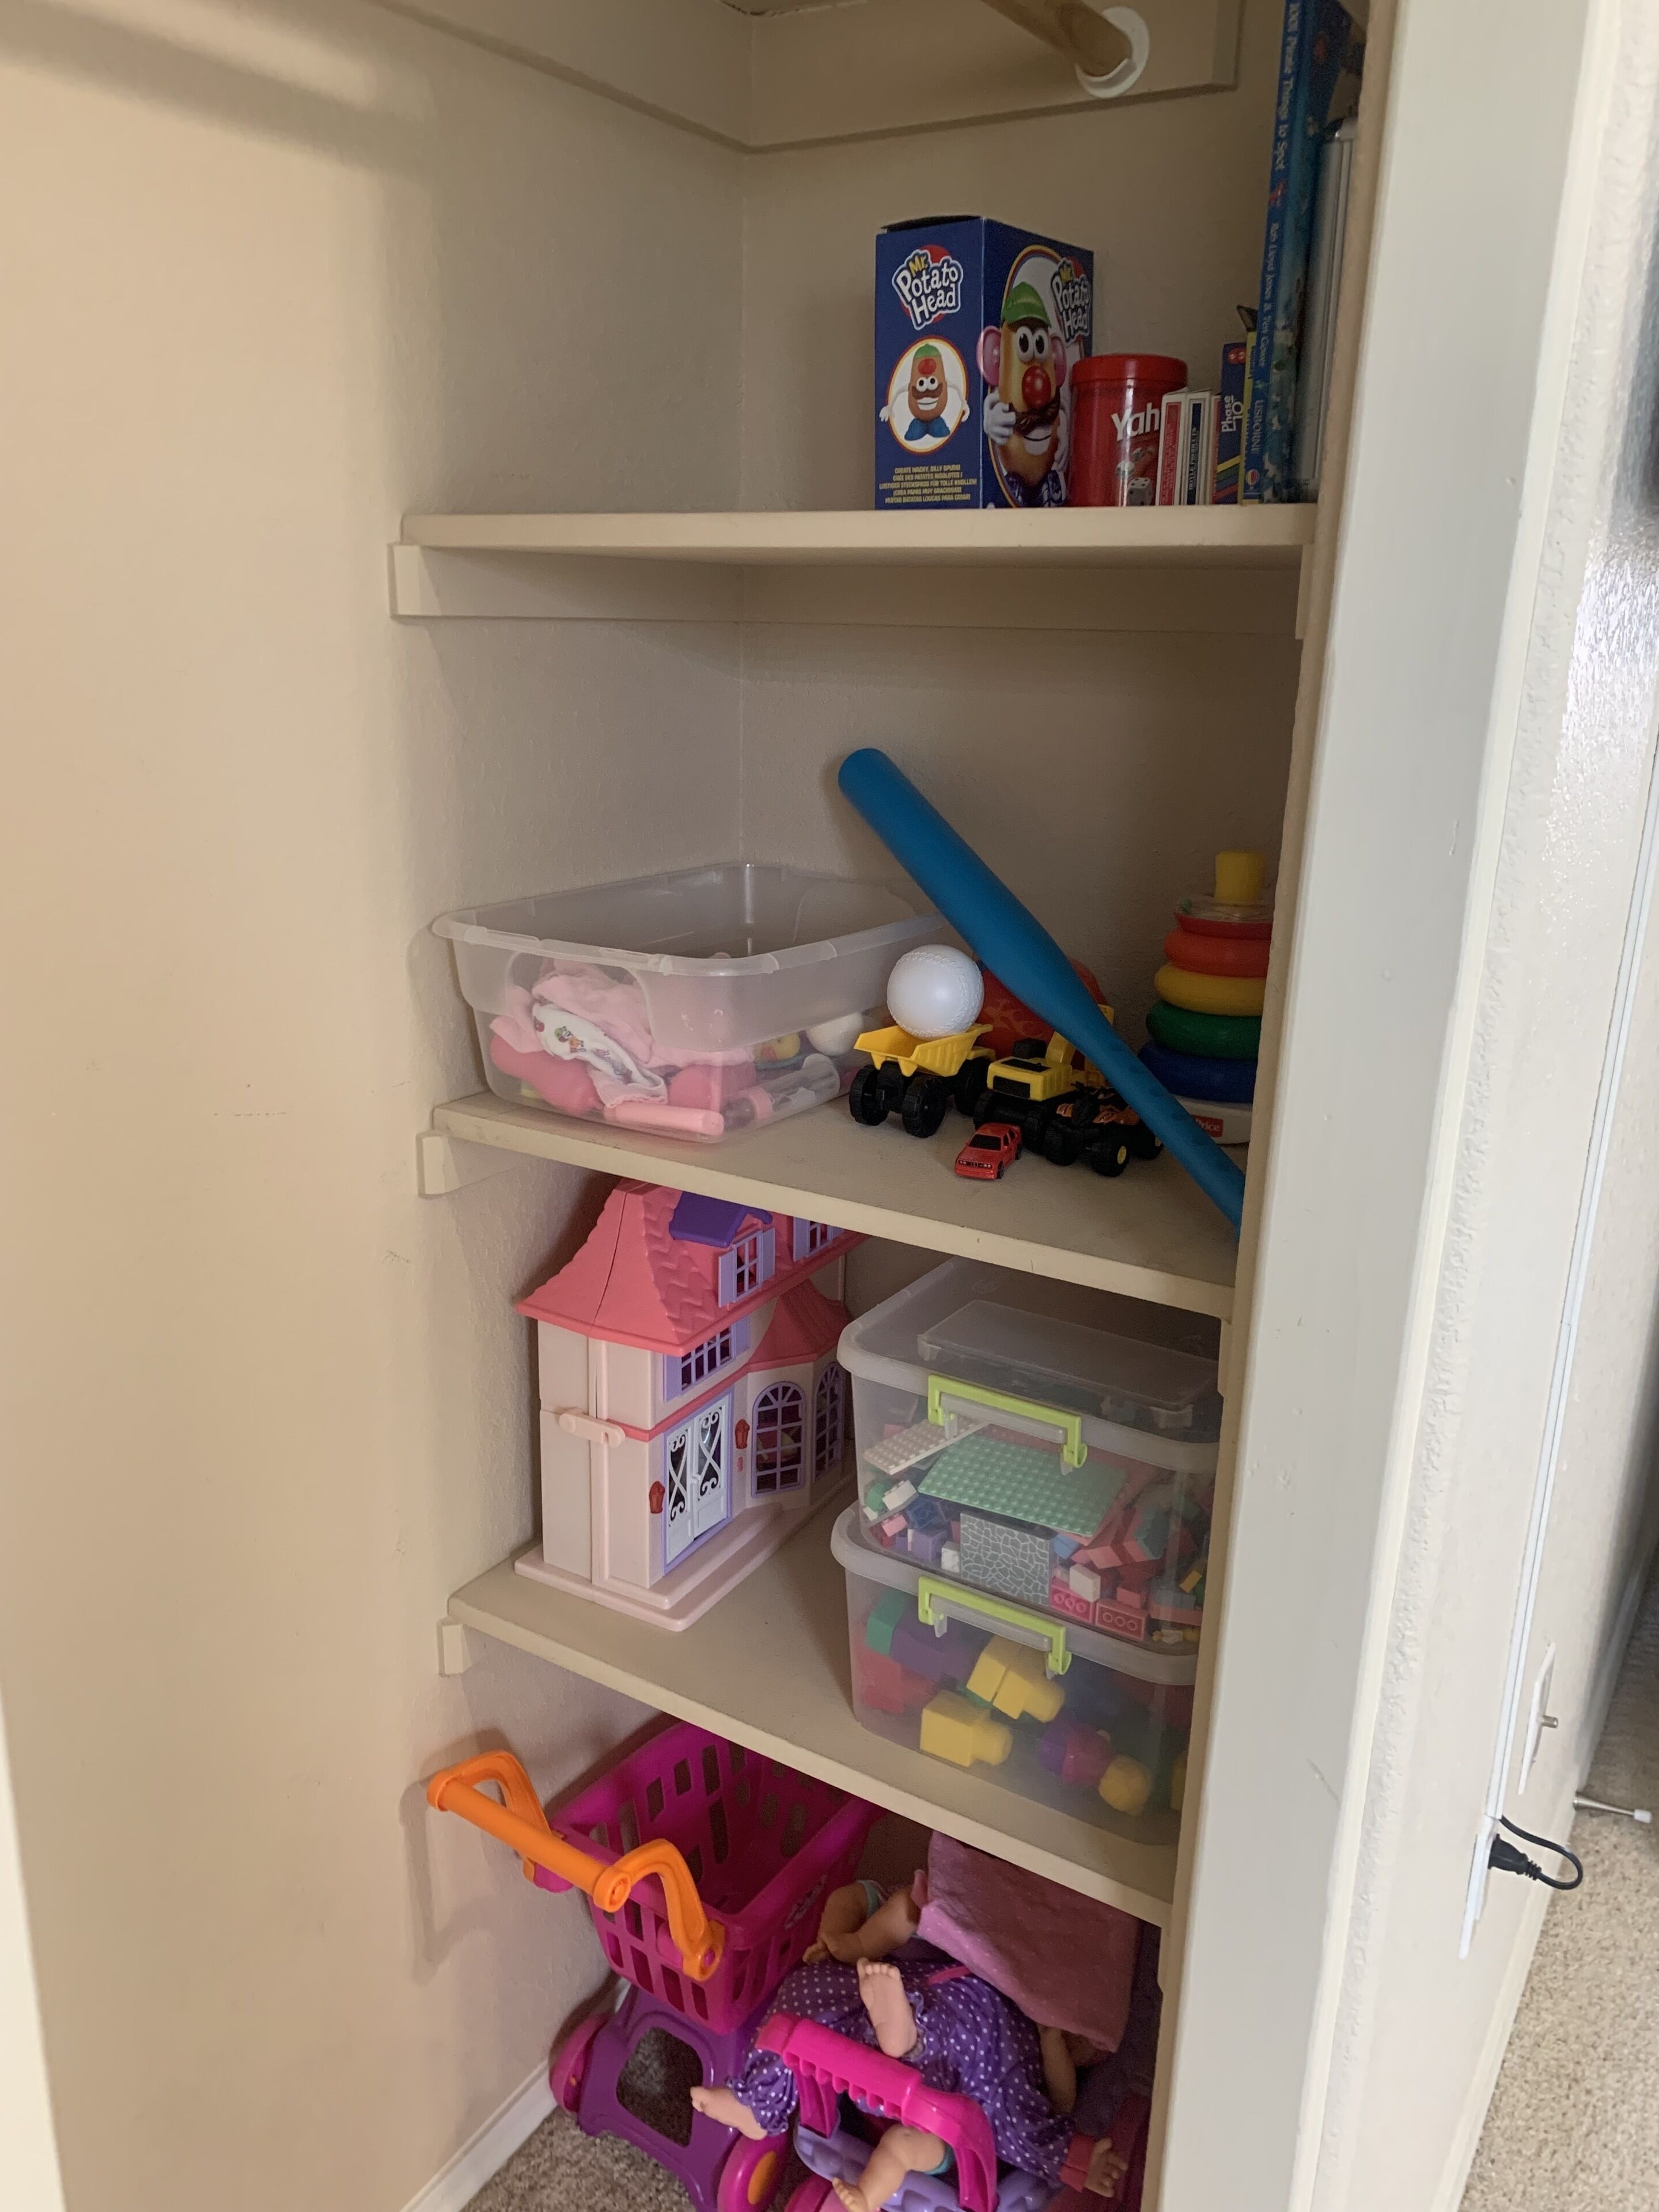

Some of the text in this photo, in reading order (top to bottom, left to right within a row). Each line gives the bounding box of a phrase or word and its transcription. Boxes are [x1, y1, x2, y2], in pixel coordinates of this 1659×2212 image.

[1279, 124, 1289, 138] to
[1275, 141, 1288, 172] Spot
[896, 262, 958, 302] Potato
[908, 255, 928, 278] Mr.
[911, 283, 956, 324] Head
[1052, 275, 1089, 313] Potato
[1062, 304, 1088, 339] Head
[1221, 395, 1234, 433] Phase
[1232, 401, 1243, 420] 10
